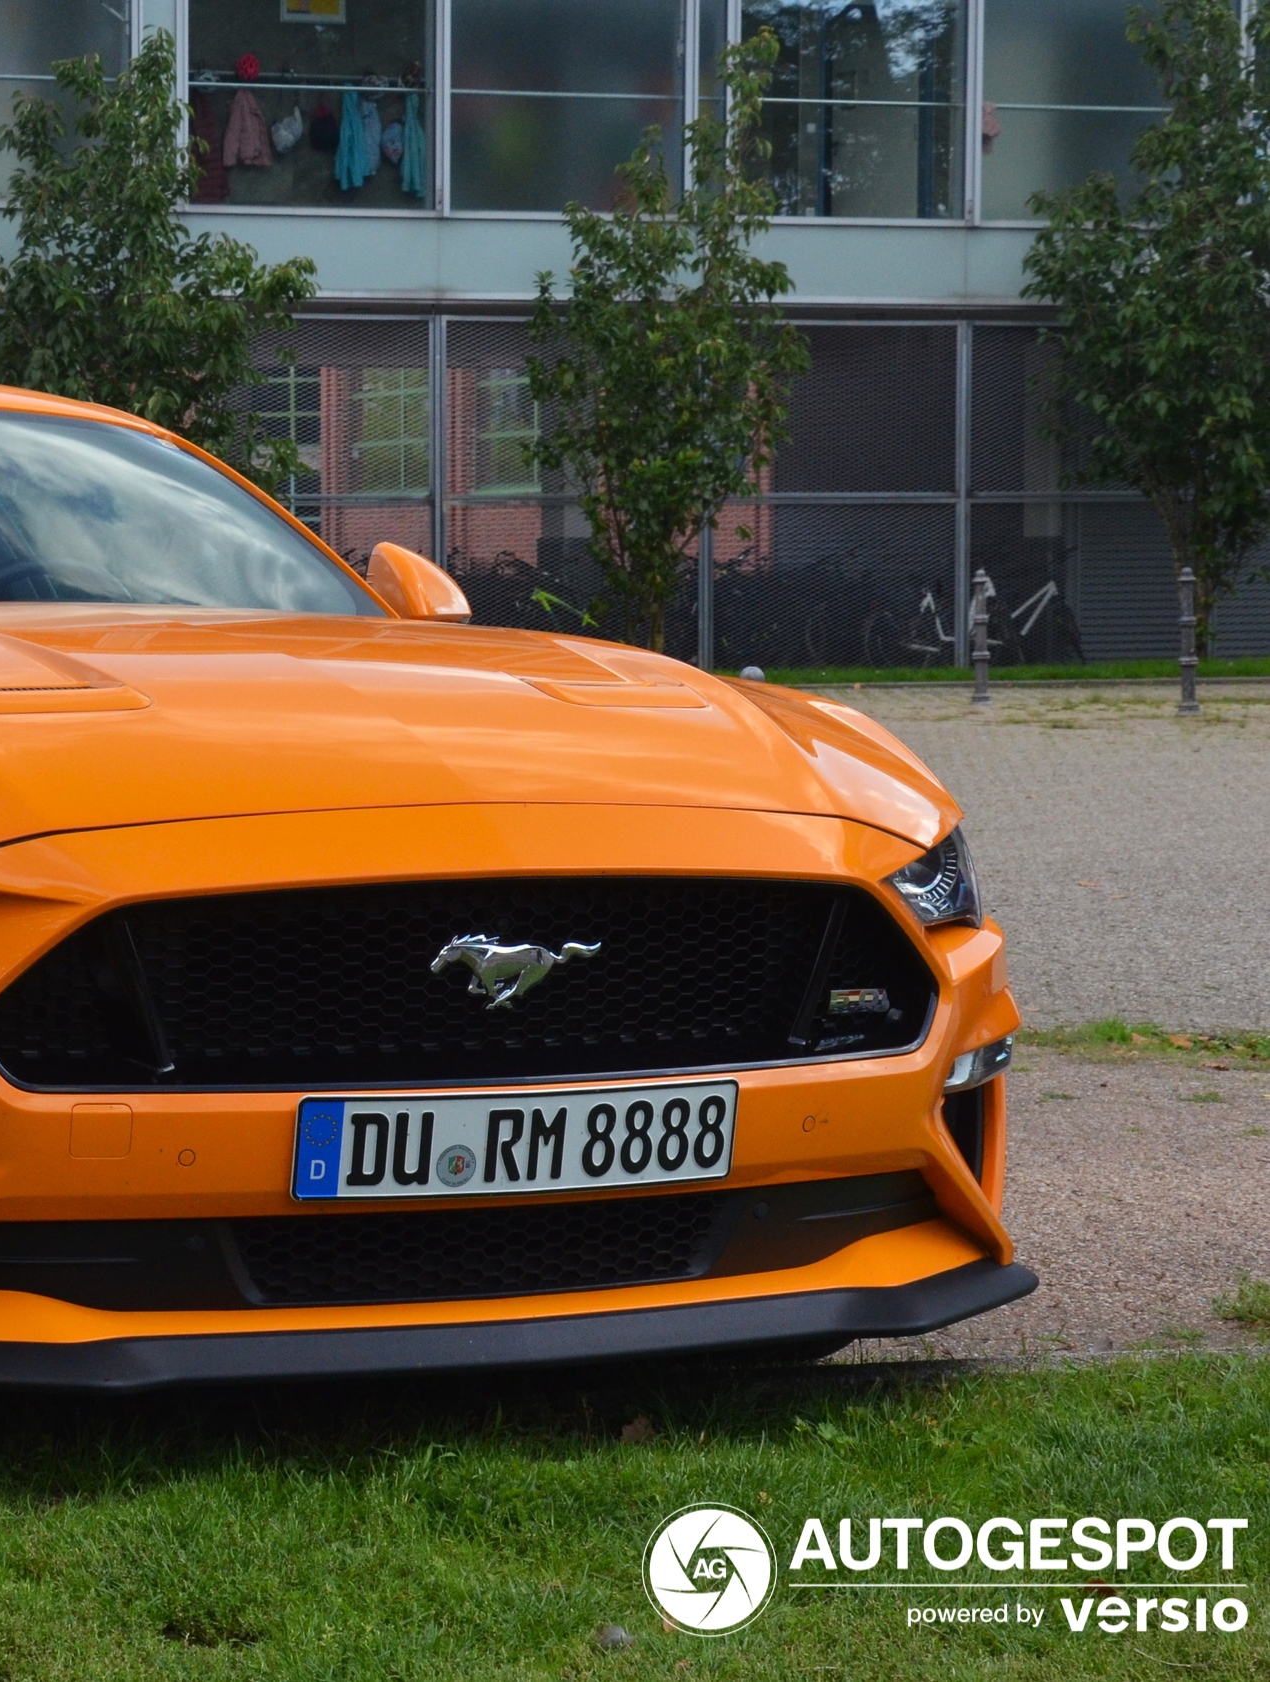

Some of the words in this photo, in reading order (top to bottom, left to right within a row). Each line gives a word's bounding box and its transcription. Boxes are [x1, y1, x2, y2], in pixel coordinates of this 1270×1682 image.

[346, 1111, 434, 1186] DU
[484, 1107, 567, 1182] RM
[582, 1094, 727, 1178] 8888
[310, 1159, 326, 1180] D
